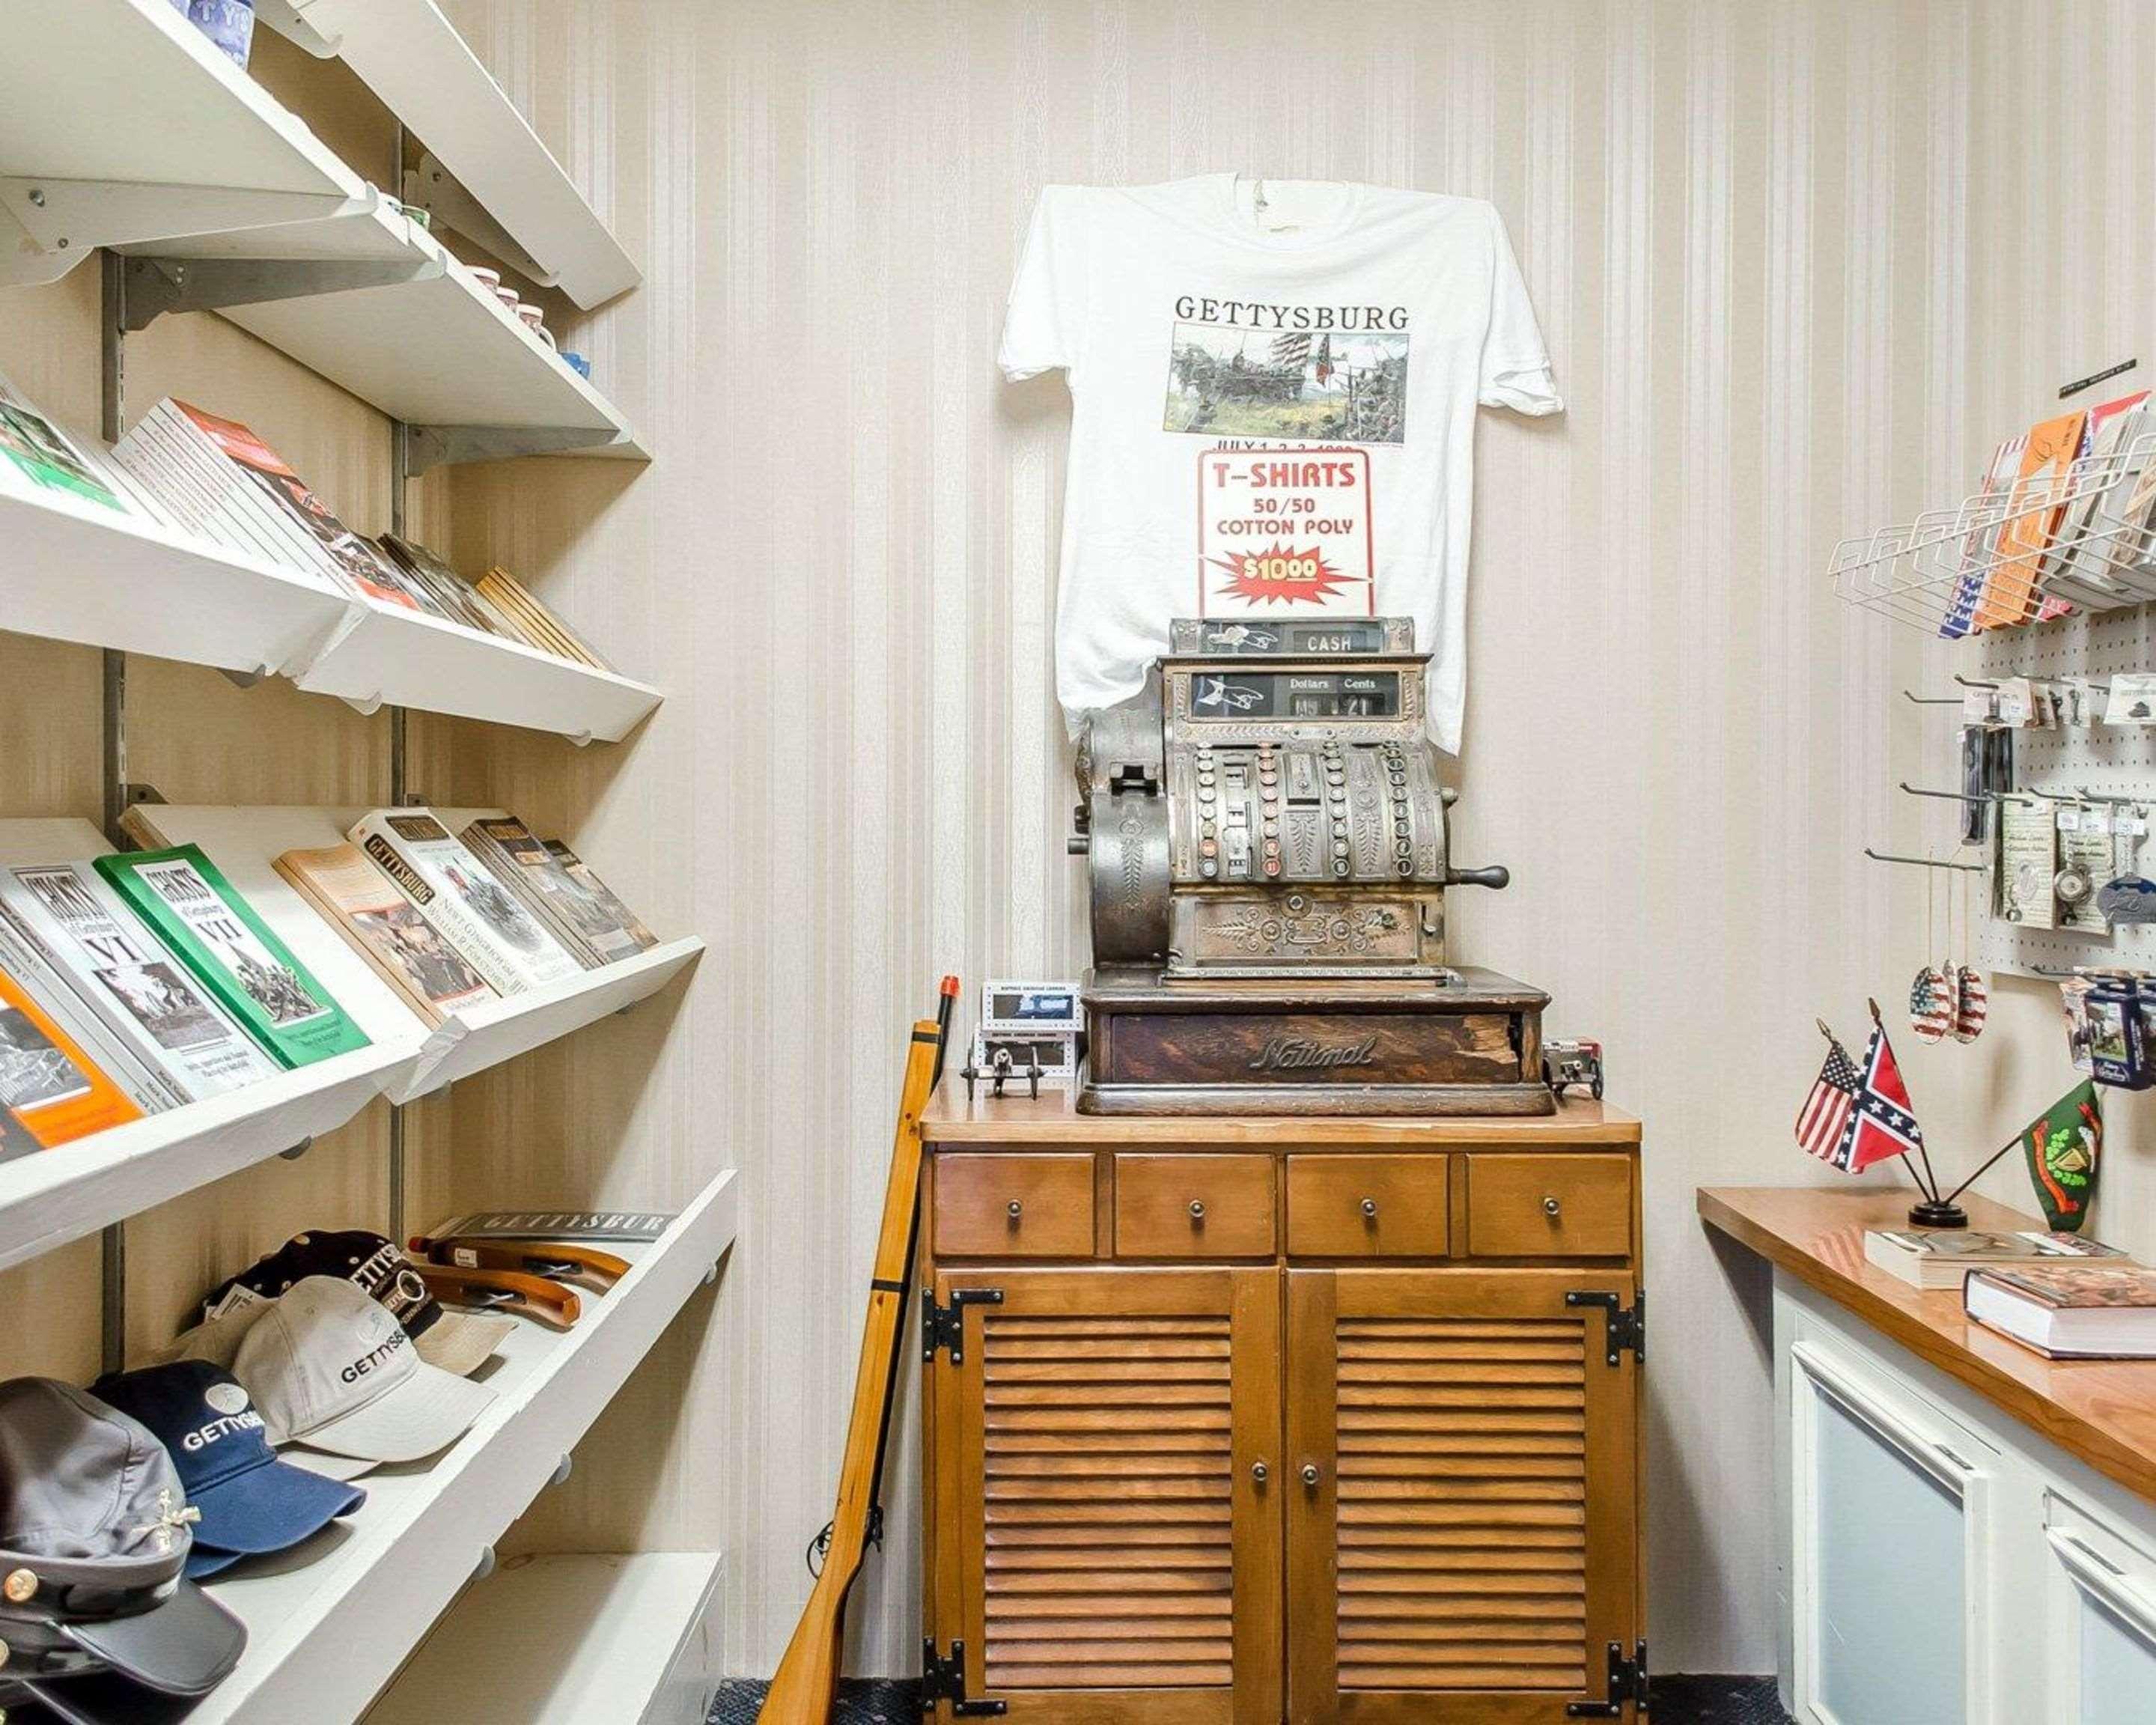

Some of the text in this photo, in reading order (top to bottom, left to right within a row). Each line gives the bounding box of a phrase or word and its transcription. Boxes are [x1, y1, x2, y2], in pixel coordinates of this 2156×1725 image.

[1175, 296, 1410, 330] GETTYSBURG
[1213, 462, 1356, 488] T-SHIRTS
[1253, 498, 1316, 516] 50/50
[1216, 519, 1354, 535] COTTON POLY
[1307, 636, 1351, 651] CASH
[1290, 678, 1376, 690] Dollars Cents
[368, 838, 433, 904] GETTYSBURG
[195, 919, 242, 942] VII
[81, 936, 141, 965] VI
[1249, 1036, 1377, 1069] National
[484, 1214, 671, 1231] GETTYSBUR
